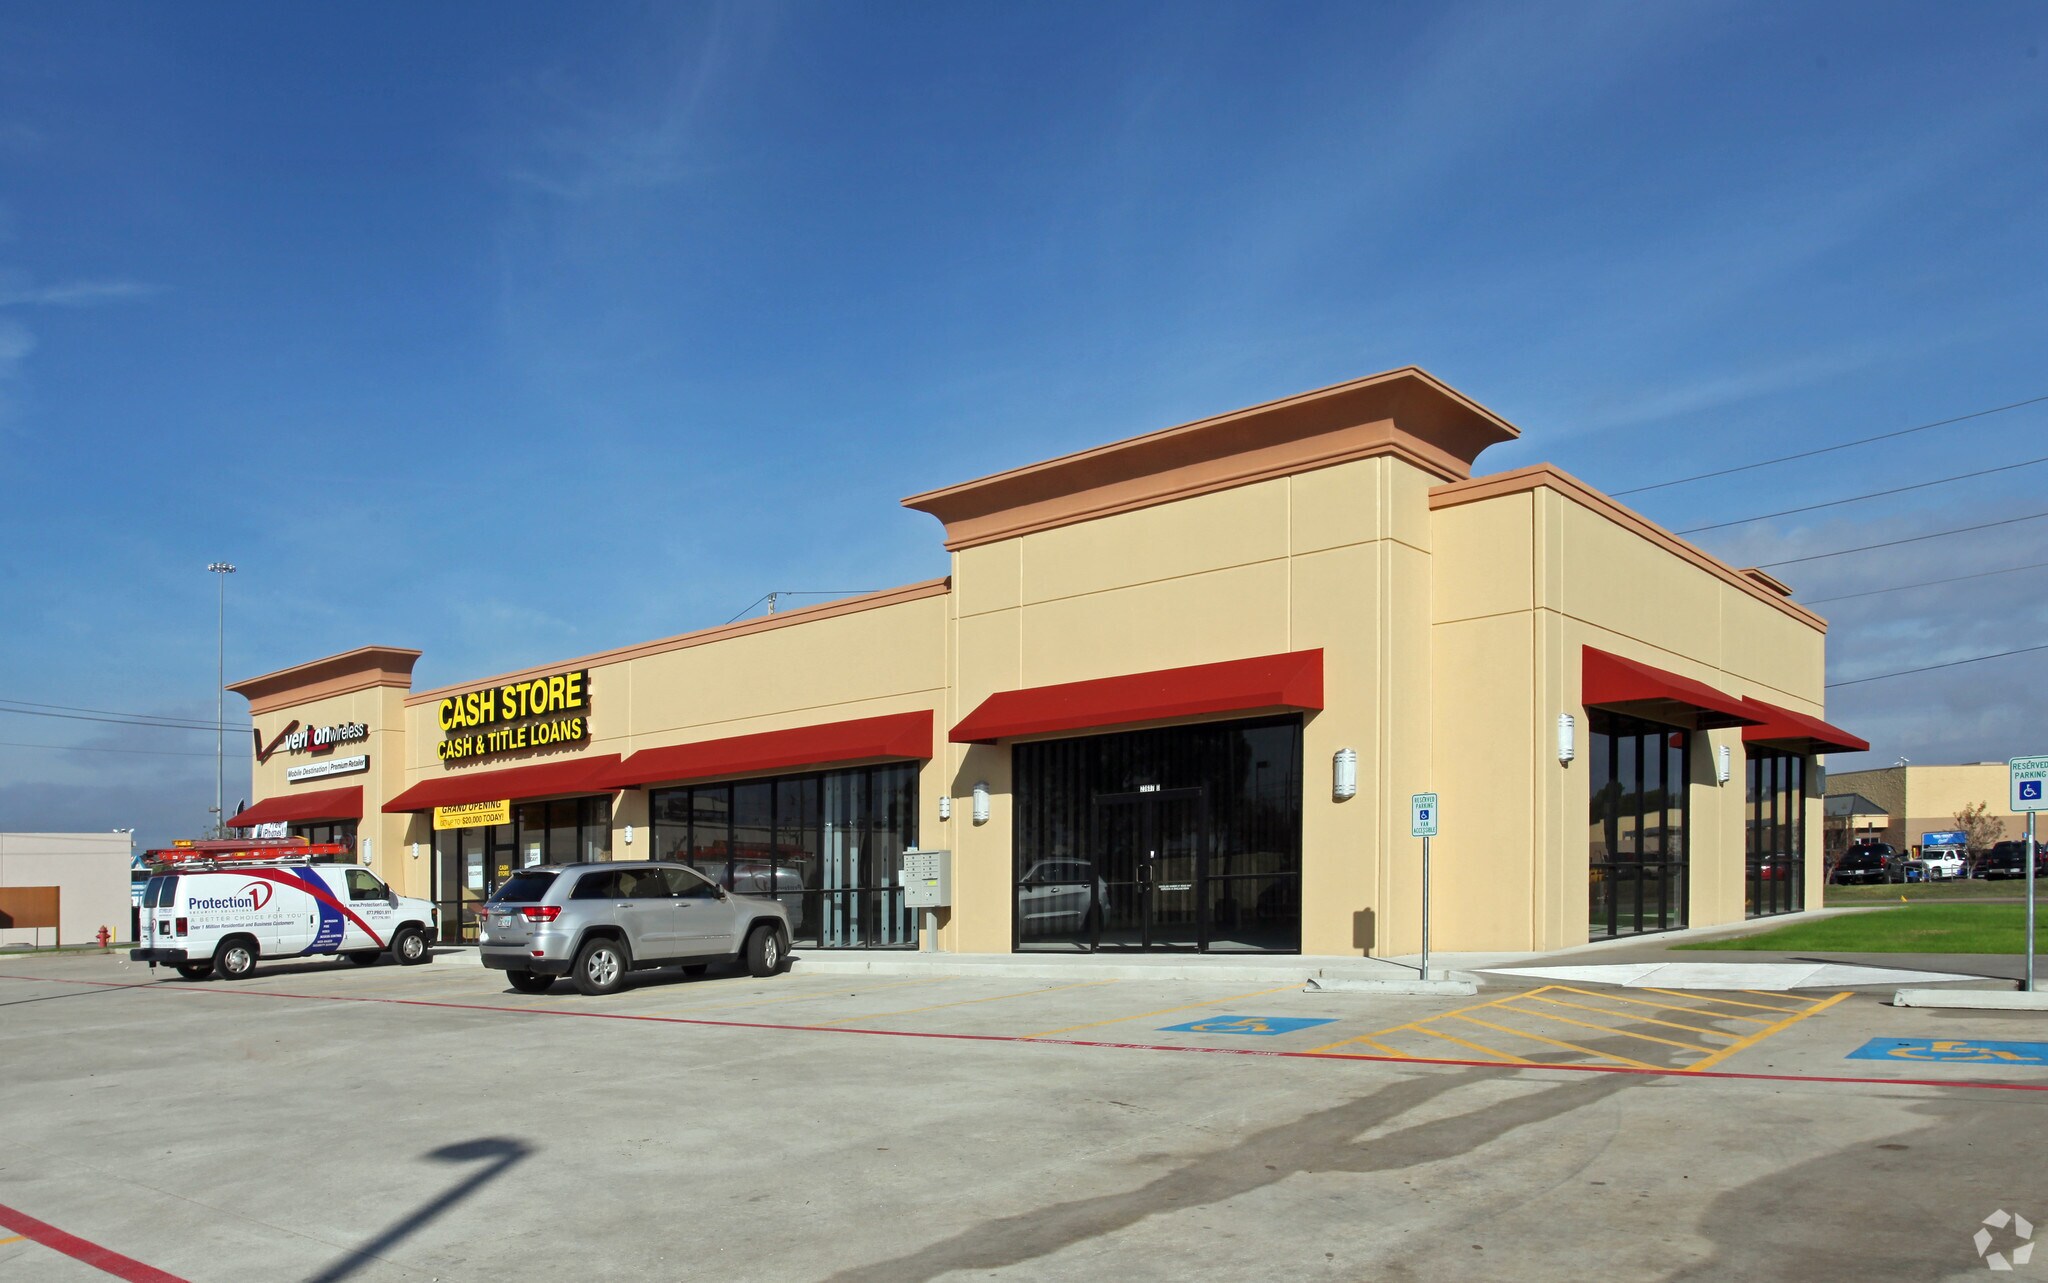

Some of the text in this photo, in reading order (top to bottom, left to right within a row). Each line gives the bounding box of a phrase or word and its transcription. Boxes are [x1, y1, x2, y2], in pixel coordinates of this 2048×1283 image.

[438, 672, 582, 731] CASH STORE
[285, 722, 364, 752] verizon wireless
[437, 717, 582, 760] CASH & TITLE LOANS
[287, 759, 365, 778] Mobile Destination Premium Retailer
[2012, 761, 2048, 770] RESERVED
[2014, 771, 2047, 779] PARKING
[442, 801, 501, 814] GRAND OPENING
[462, 815, 482, 825] $20,000
[483, 813, 504, 822] TODAY!
[188, 896, 252, 910] Protection
[234, 913, 264, 921] CHOICE
